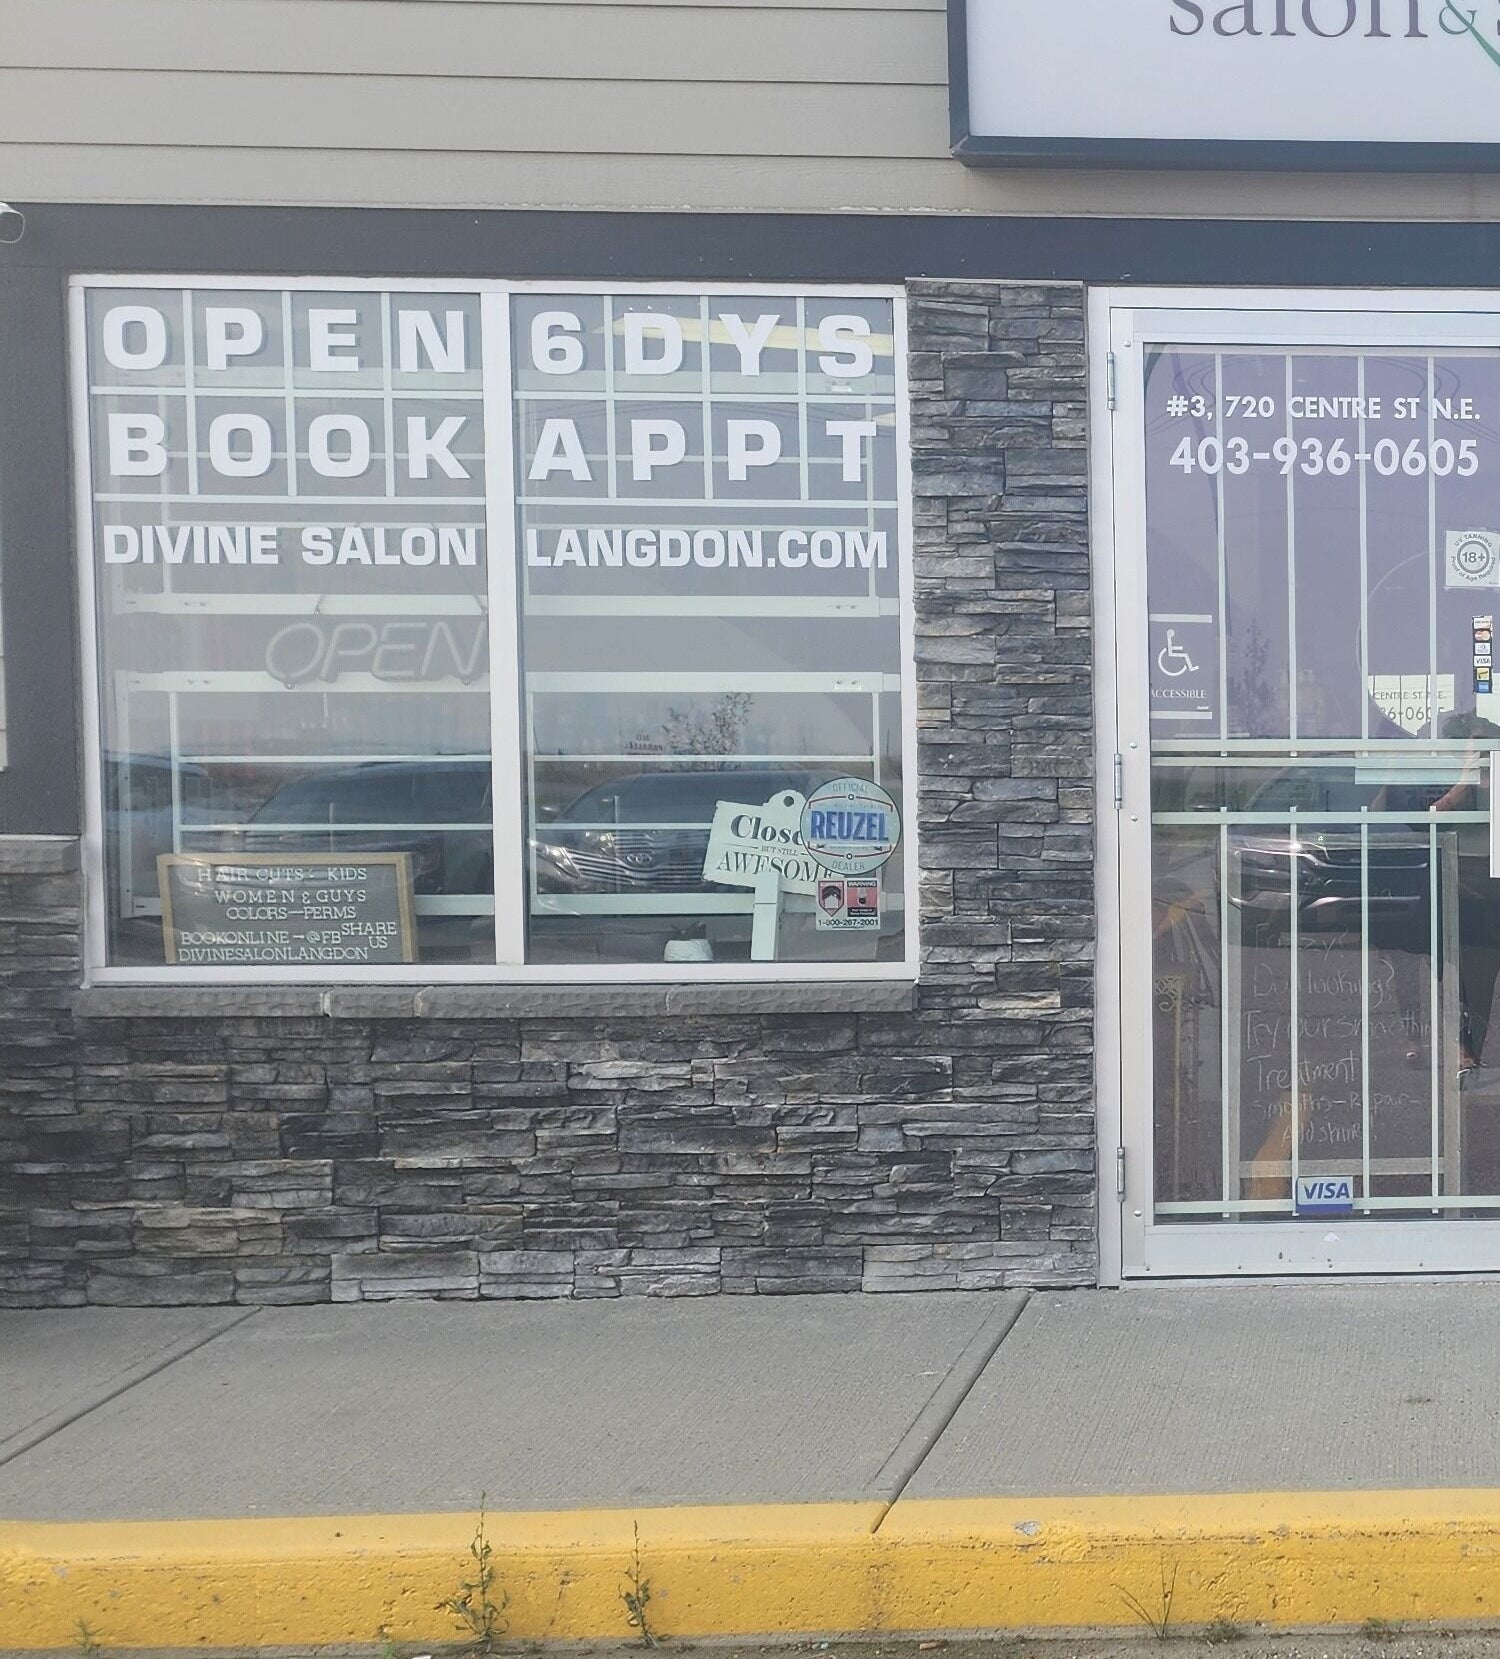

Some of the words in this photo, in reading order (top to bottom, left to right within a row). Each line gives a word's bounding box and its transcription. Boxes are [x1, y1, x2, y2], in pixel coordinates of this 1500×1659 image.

[103, 305, 466, 373] OPEN
[530, 311, 874, 378] 6DYS
[1166, 395, 1214, 421] #3,
[1225, 395, 1275, 418] 720
[1287, 396, 1382, 420] CENTRE
[1393, 397, 1420, 419] ST
[1431, 397, 1481, 420] N.E.
[107, 413, 471, 479] BOOK
[527, 418, 877, 482] APPT
[1169, 436, 1480, 476] 403-936-0605
[103, 525, 279, 565] DIVINE
[301, 526, 477, 566] SALON
[526, 528, 888, 568] LANGDON.COM
[1461, 551, 1486, 563] 18+
[265, 620, 487, 681] OPEN
[730, 814, 805, 846] Close
[810, 810, 889, 841] REUZEL
[198, 867, 250, 882] HAIR
[327, 867, 367, 881] KIDS
[214, 889, 295, 903] WOMEN
[301, 891, 311, 905] &
[315, 889, 367, 903] GUYS
[341, 921, 397, 936] SHARE
[177, 946, 369, 962] DIVINESALONLANGDON
[368, 935, 389, 949] US
[1303, 1182, 1351, 1200] VISA
